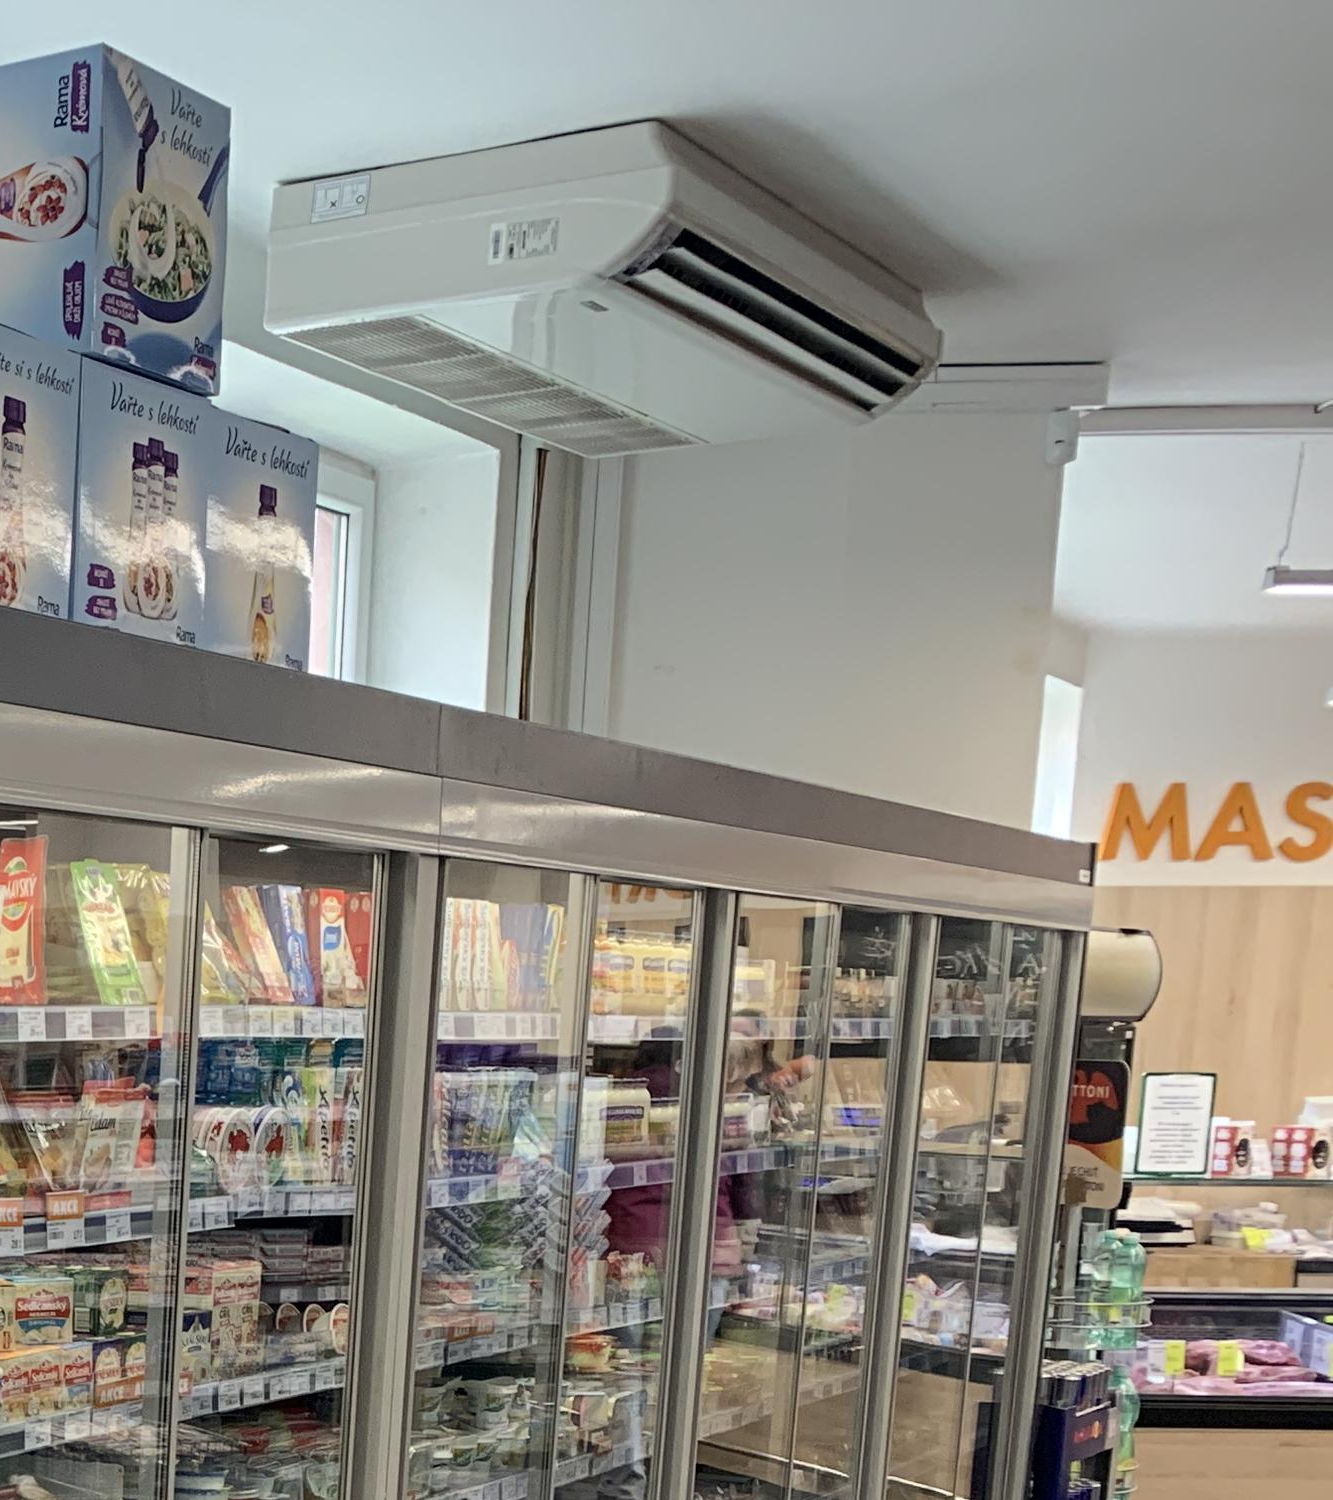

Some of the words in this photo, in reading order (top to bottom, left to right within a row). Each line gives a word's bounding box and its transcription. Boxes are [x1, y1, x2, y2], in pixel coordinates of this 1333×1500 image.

[54, 74, 70, 129] Rama
[170, 87, 203, 129] Vařte
[161, 131, 167, 144] s
[170, 129, 214, 168] lehkostí
[14, 358, 24, 379] si
[27, 367, 33, 381] s
[35, 361, 74, 397] lehkostí
[109, 381, 144, 418] Vařte
[147, 409, 154, 421] s
[158, 400, 200, 436] lehkostí
[2, 437, 24, 455] Rama
[224, 426, 258, 465] Vařte
[261, 454, 267, 466] s
[270, 449, 311, 481] lehkostí
